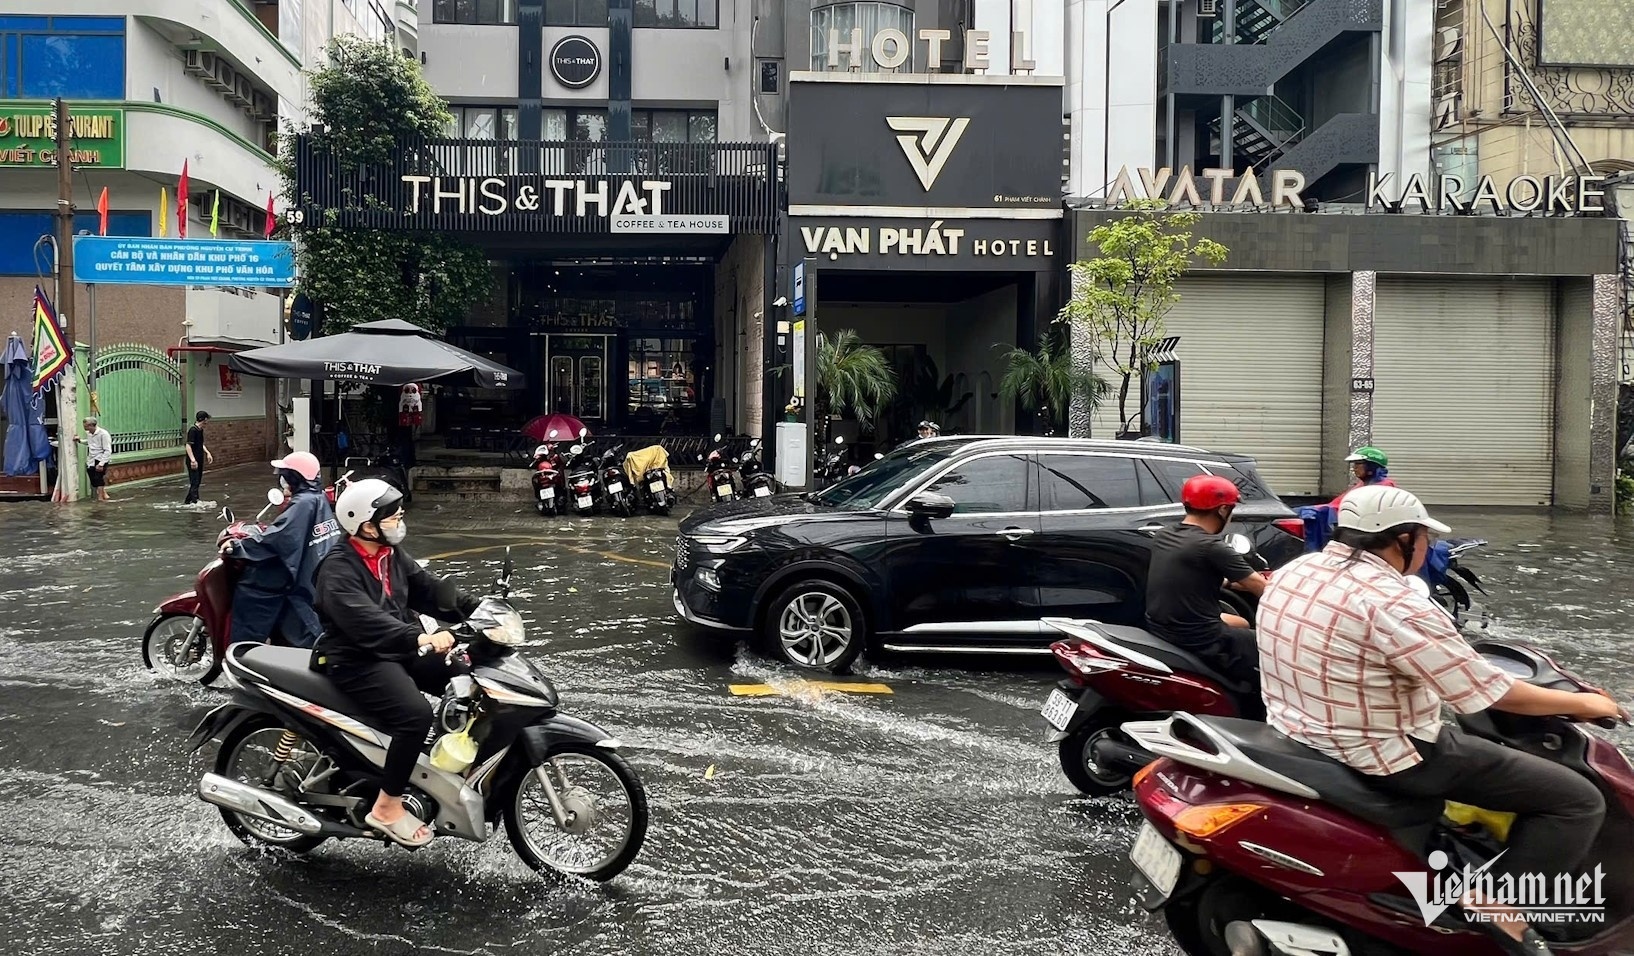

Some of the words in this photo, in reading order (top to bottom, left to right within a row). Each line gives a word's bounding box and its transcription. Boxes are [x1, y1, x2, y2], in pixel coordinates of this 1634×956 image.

[828, 28, 1036, 70] HOTEL
[14, 115, 43, 138] TULIP
[1105, 164, 1306, 208] AVATAR
[1366, 171, 1606, 212] KARAOKE
[401, 175, 508, 215] THIS
[514, 185, 540, 211] &
[545, 179, 672, 217] THAT
[994, 195, 1003, 203] 61
[286, 210, 304, 224] 59
[616, 219, 655, 229] COFFEE
[657, 220, 666, 229] &
[667, 220, 687, 229] TEA
[689, 220, 724, 229] HOUSE
[800, 226, 870, 261] VẠN
[879, 220, 965, 255] PHÁT
[974, 239, 1054, 256] HOTEL
[110, 249, 129, 260] CÁN
[131, 250, 144, 261] BỘ
[146, 250, 158, 260] VÀ
[160, 250, 185, 261] NHÂN
[187, 251, 206, 261] DÂN
[208, 253, 226, 262] KHU
[228, 252, 246, 263] PHỐ
[248, 254, 259, 263] 16
[95, 261, 122, 271] QUYẾT
[126, 261, 146, 272] TÂM
[148, 262, 165, 272] XÂY
[168, 264, 193, 274] DỰNG
[195, 265, 214, 273] KHU
[215, 264, 234, 274] PHỐ
[236, 264, 254, 274] VĂN
[255, 265, 274, 275] HÓA
[1353, 380, 1374, 389] 63-65
